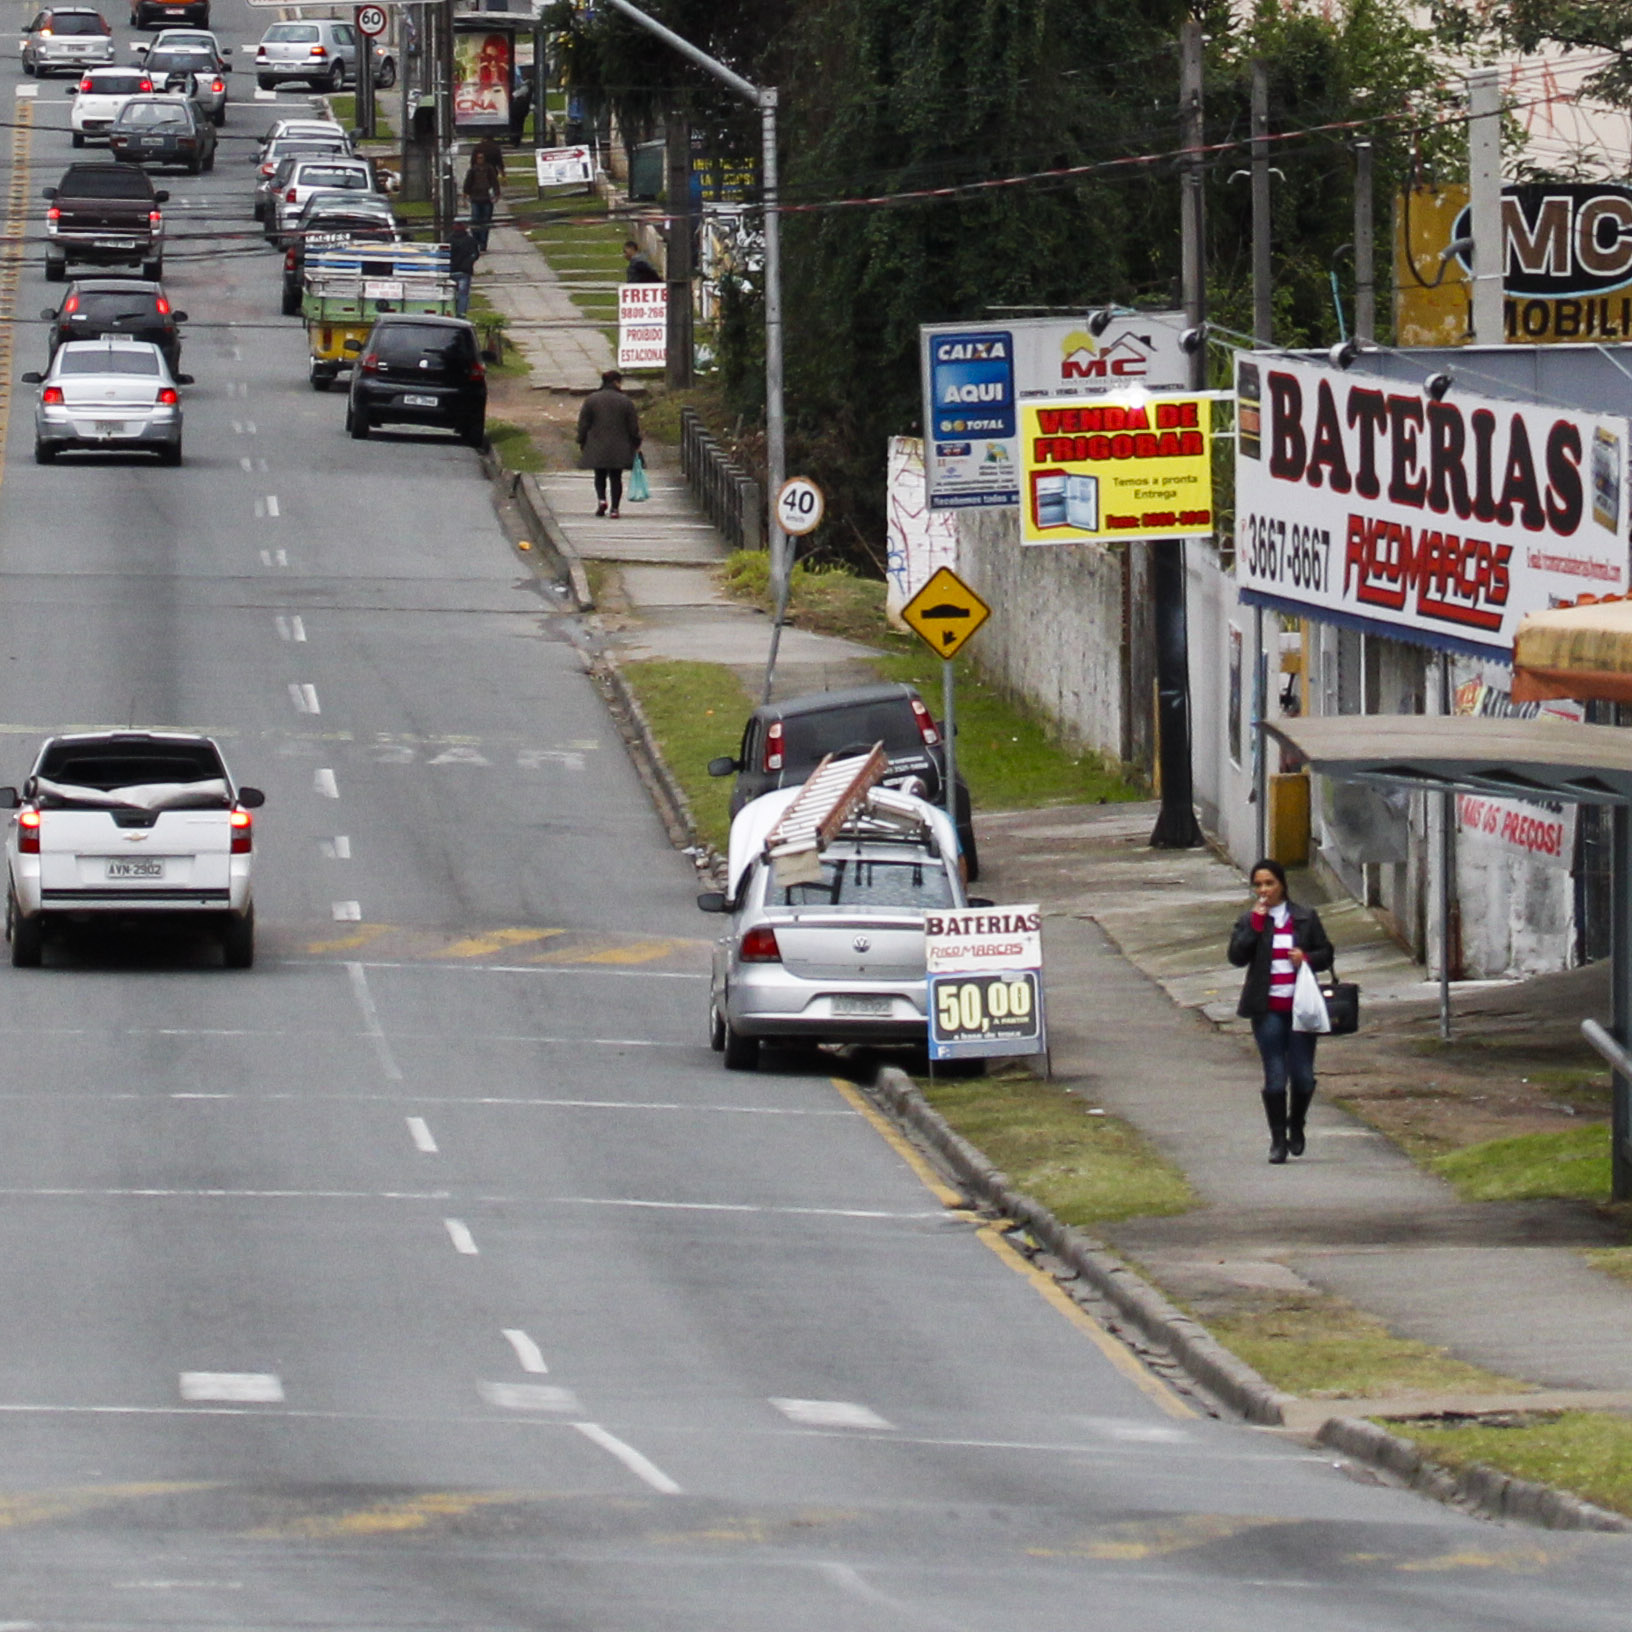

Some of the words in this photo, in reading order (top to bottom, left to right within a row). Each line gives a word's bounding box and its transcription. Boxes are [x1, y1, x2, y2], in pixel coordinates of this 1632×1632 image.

[361, 11, 380, 25] 60
[456, 99, 498, 111] CNA
[626, 329, 663, 342] PROIBIDO
[937, 342, 1006, 362] CAIXA
[1061, 357, 1147, 379] MC
[944, 382, 1003, 405] AQUI
[967, 419, 1004, 431] TOTAL
[1036, 405, 1150, 435] VENDA
[1156, 402, 1199, 429] DE
[1033, 430, 1204, 464] FRIGOBAR
[1268, 369, 1584, 537] BATERIAS
[1112, 476, 1149, 488] Temos
[1161, 474, 1199, 488] pronta
[783, 488, 814, 514] 40
[1134, 488, 1177, 501] Entrega
[1247, 512, 1331, 593] 3667-8667
[1342, 511, 1514, 633] RICOMARCAS
[1501, 810, 1564, 858] PREÇOS!
[926, 913, 1042, 937] BATERIAS
[937, 981, 1031, 1033] 50,00
